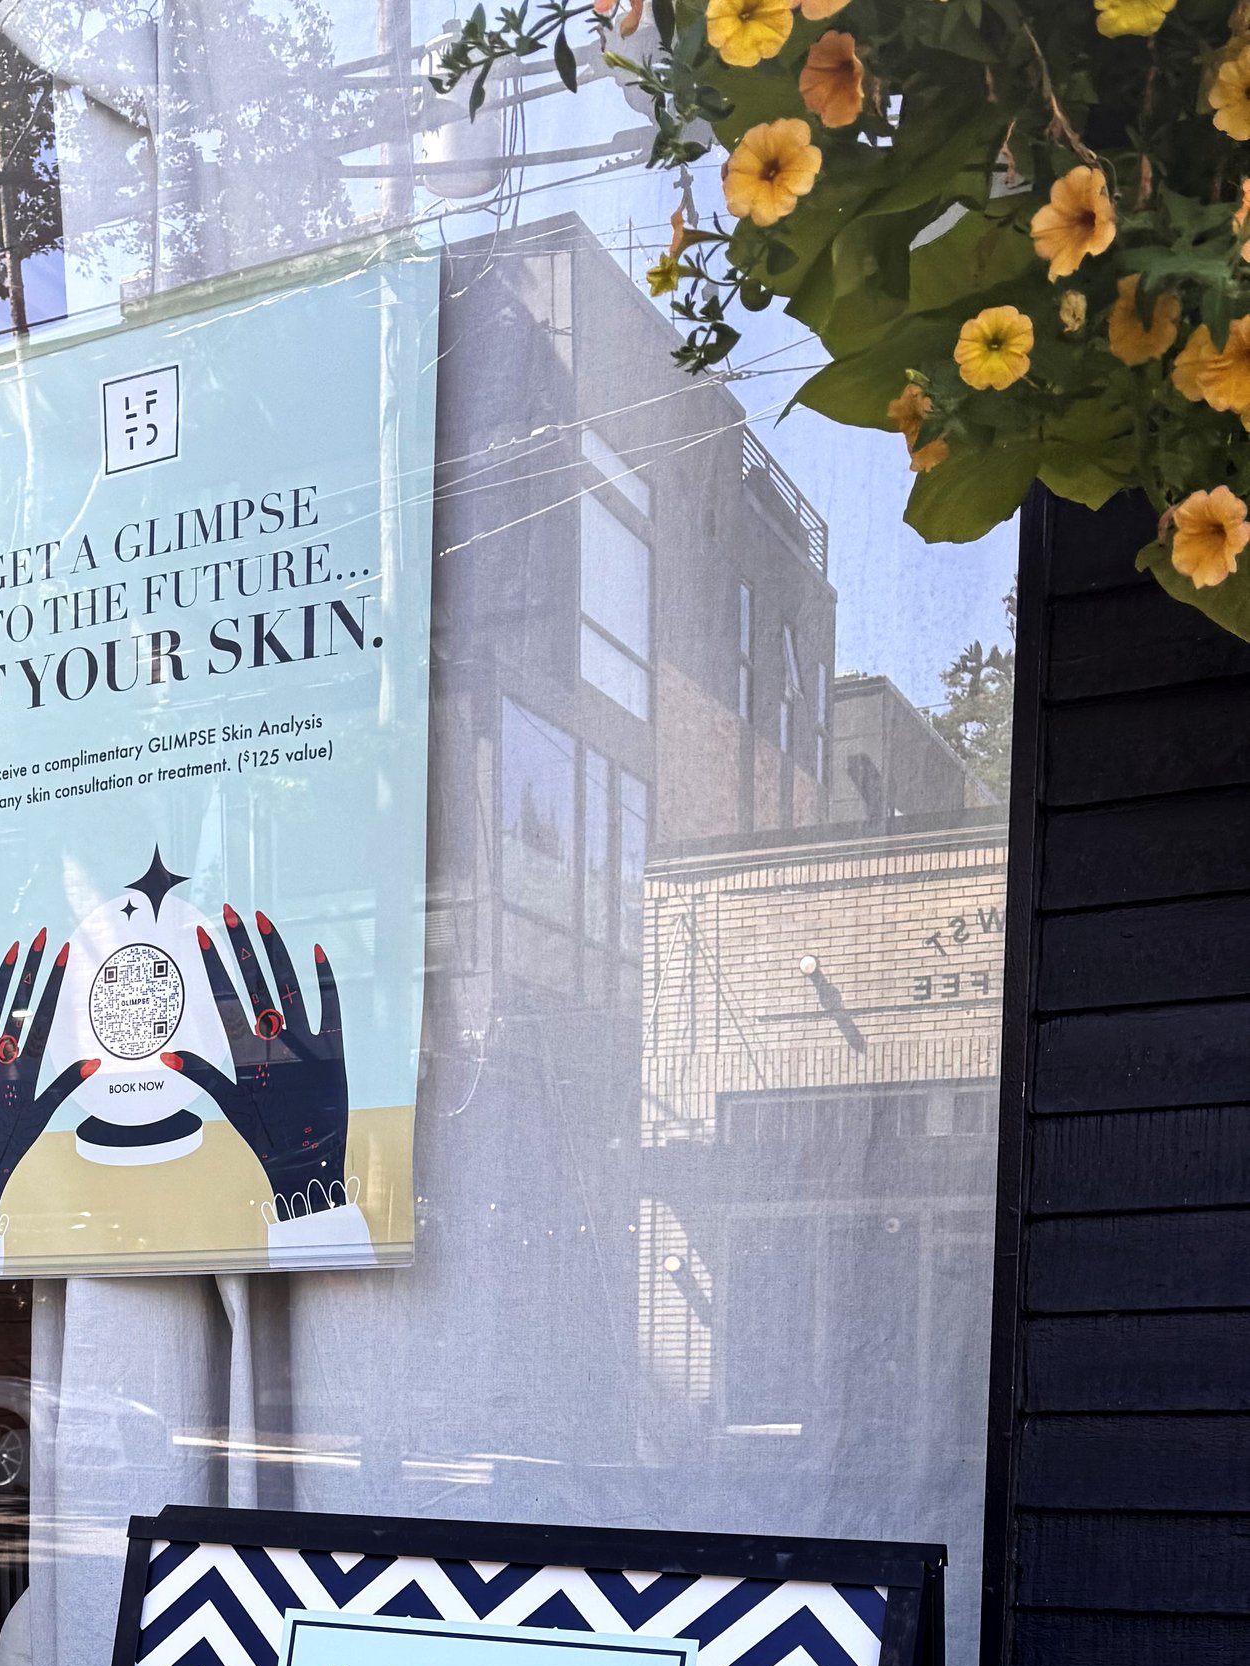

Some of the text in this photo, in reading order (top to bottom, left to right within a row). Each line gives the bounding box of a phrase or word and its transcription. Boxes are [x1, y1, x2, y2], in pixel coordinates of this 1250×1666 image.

[70, 534, 100, 574] A
[114, 486, 318, 562] GLIMPSE
[43, 582, 128, 635] THE
[142, 543, 370, 615] FUTURE...
[15, 630, 189, 709] YOUR
[208, 595, 384, 675] SKIN.
[0, 795, 22, 811] any
[27, 787, 50, 804] skin
[55, 773, 133, 799] consultation
[138, 772, 153, 784] or
[158, 758, 231, 781] treatment.
[285, 740, 333, 763] value)
[32, 764, 40, 774] a
[44, 745, 143, 773] complimentary
[148, 728, 216, 753] GLIMPSE
[222, 724, 252, 742] Skin
[257, 714, 322, 737] Analysis
[109, 1080, 164, 1094] BOOK NOW
